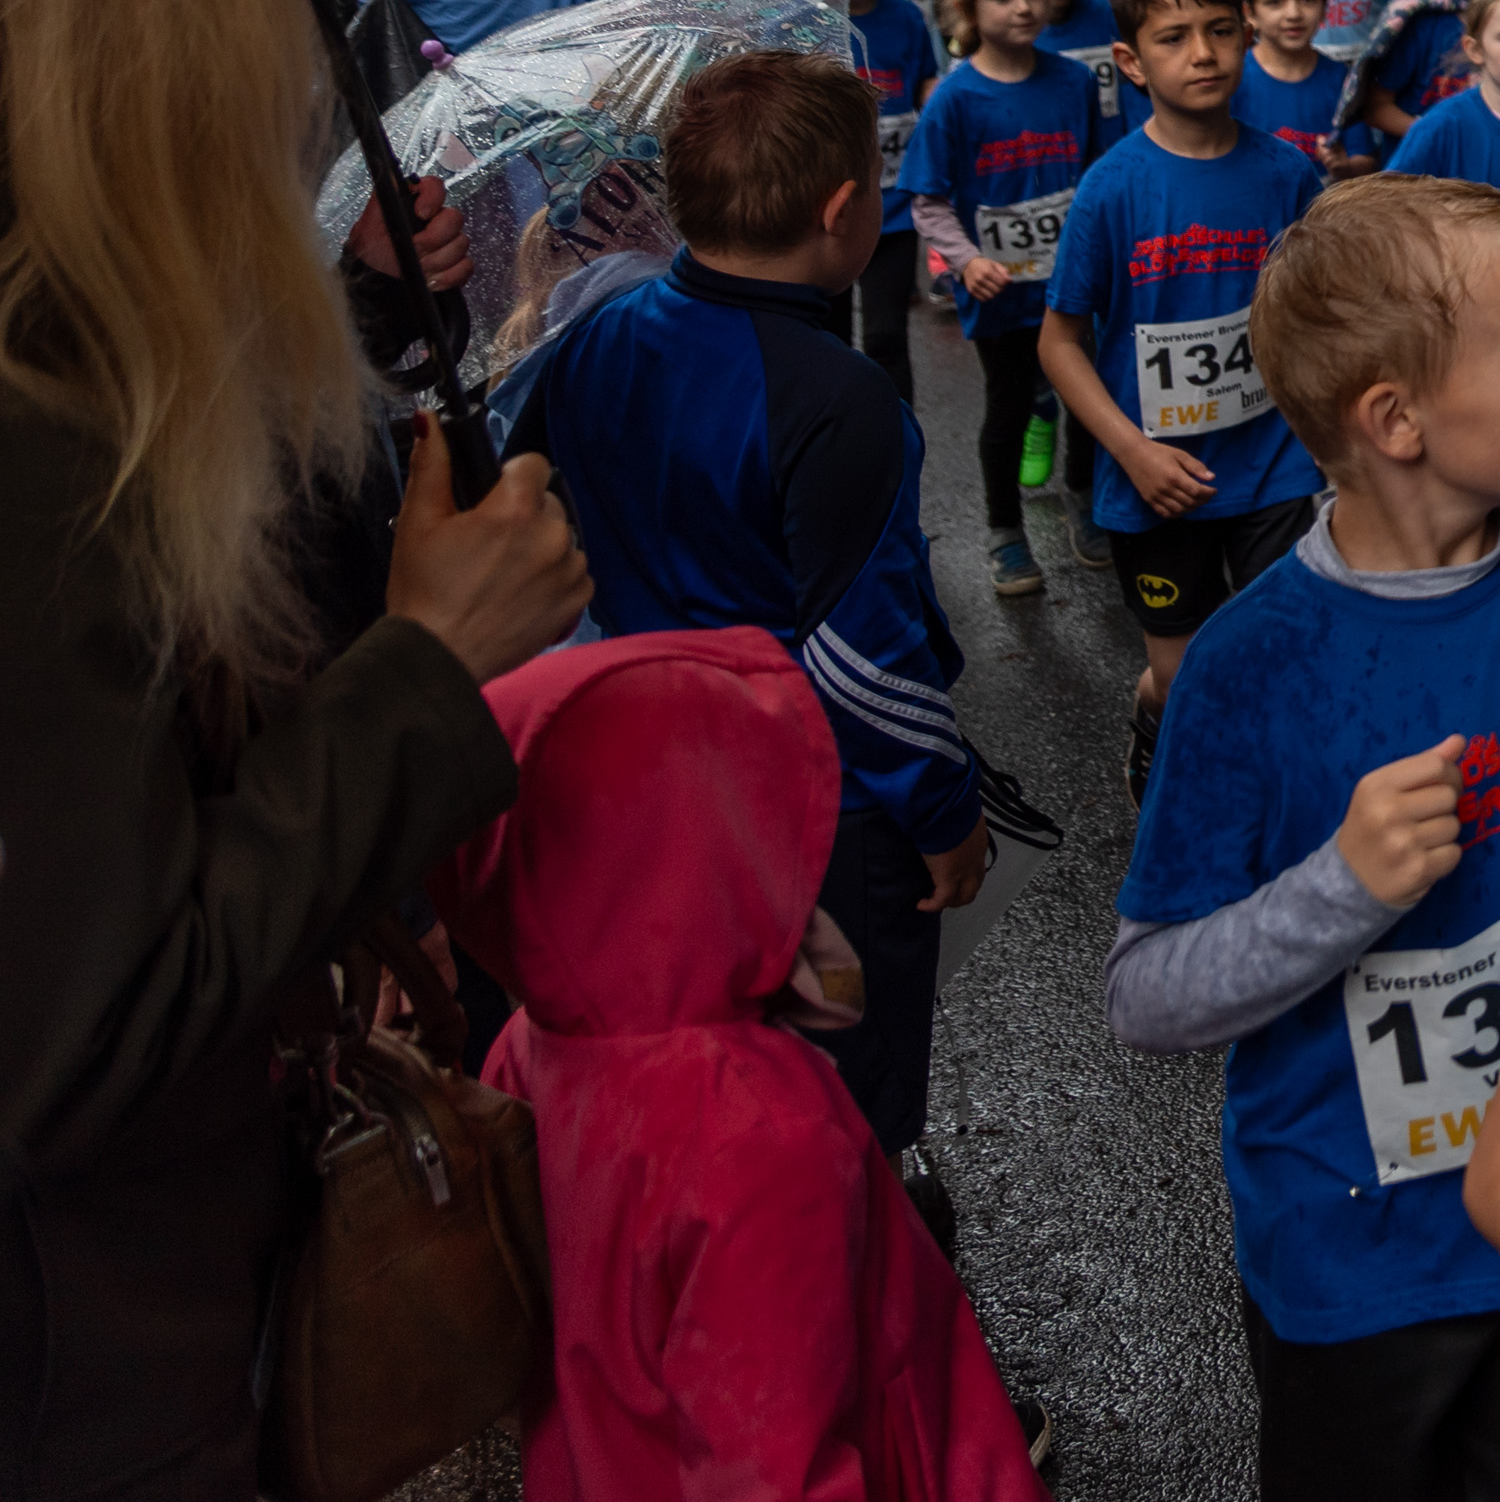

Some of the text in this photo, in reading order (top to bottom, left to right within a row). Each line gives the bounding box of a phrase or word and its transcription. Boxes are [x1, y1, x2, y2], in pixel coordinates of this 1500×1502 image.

[1206, 382, 1242, 398] Salem
[1159, 400, 1220, 428] EWE
[1365, 953, 1497, 993] Everstener
